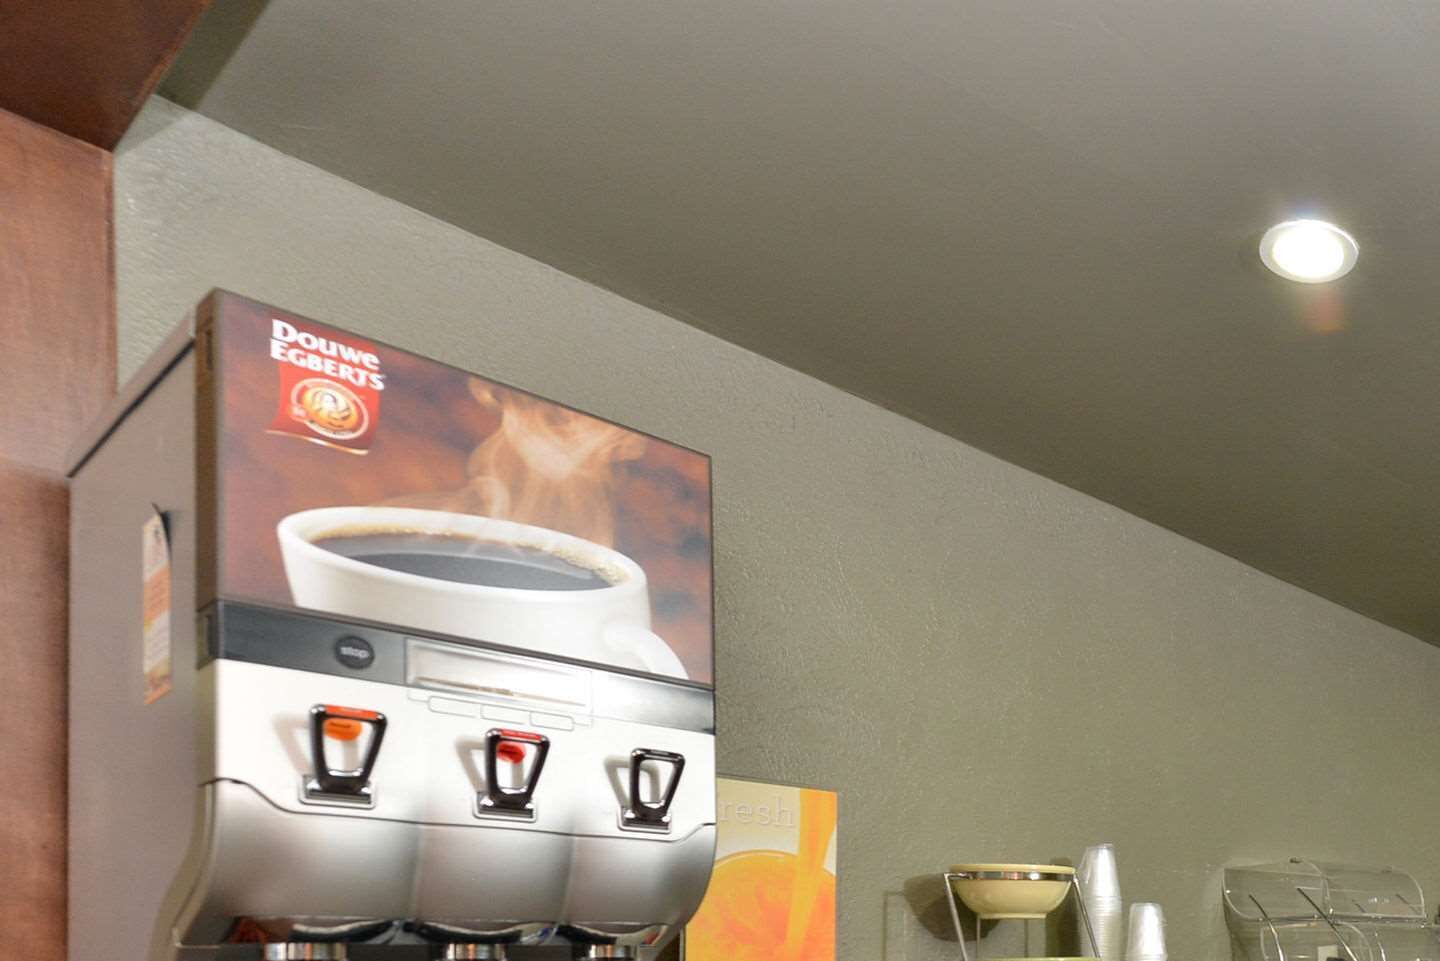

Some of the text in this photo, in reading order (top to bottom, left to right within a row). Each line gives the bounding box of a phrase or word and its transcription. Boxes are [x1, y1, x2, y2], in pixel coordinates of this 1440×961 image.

[270, 338, 385, 391] EGBERTS
[340, 646, 369, 659] stop
[719, 795, 796, 829] resh
